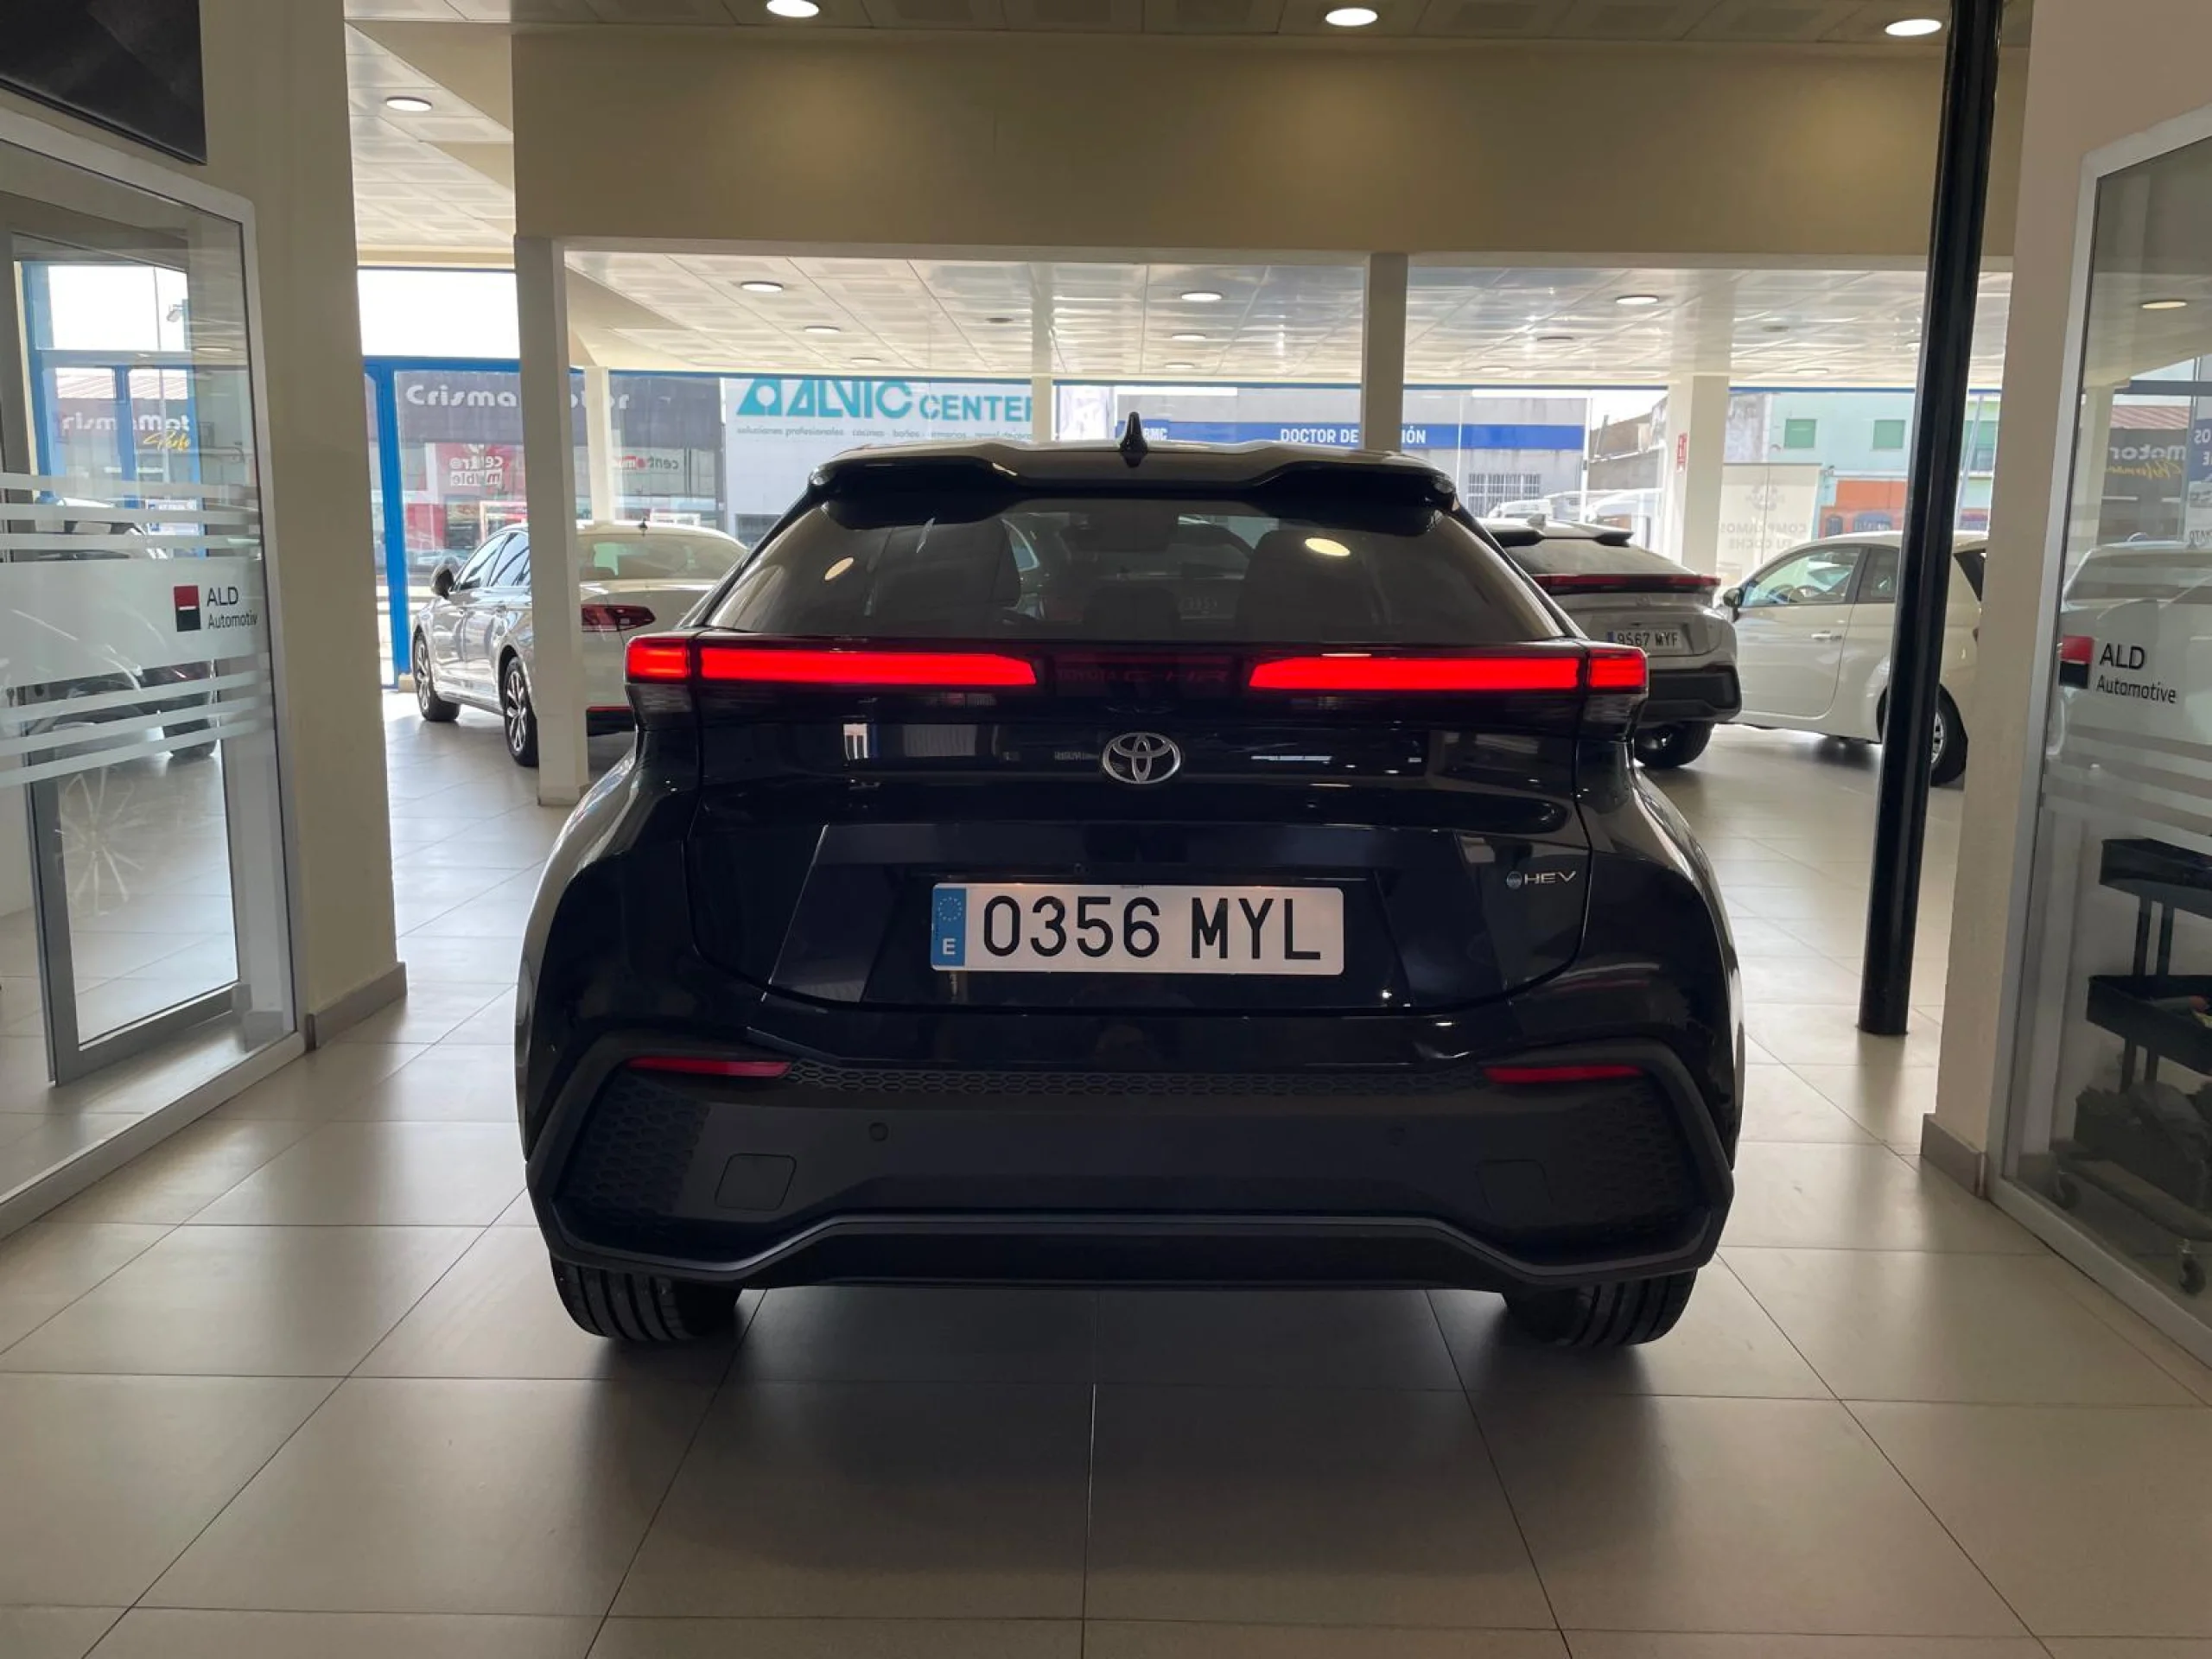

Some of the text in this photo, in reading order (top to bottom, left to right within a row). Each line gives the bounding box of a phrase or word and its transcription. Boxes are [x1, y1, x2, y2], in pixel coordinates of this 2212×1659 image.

[786, 378, 913, 419] ALVIC
[1281, 428, 1336, 443] DOCTOR
[1340, 429, 1359, 443] DE
[207, 586, 238, 607] ALD
[208, 609, 258, 630] Automotiv
[1617, 632, 1650, 646] 9567
[2099, 642, 2146, 671] ALD
[2095, 674, 2177, 704] Automotive
[1524, 870, 1577, 886] HEV
[983, 895, 1321, 960] 0356 MYL
[943, 938, 957, 956] E
